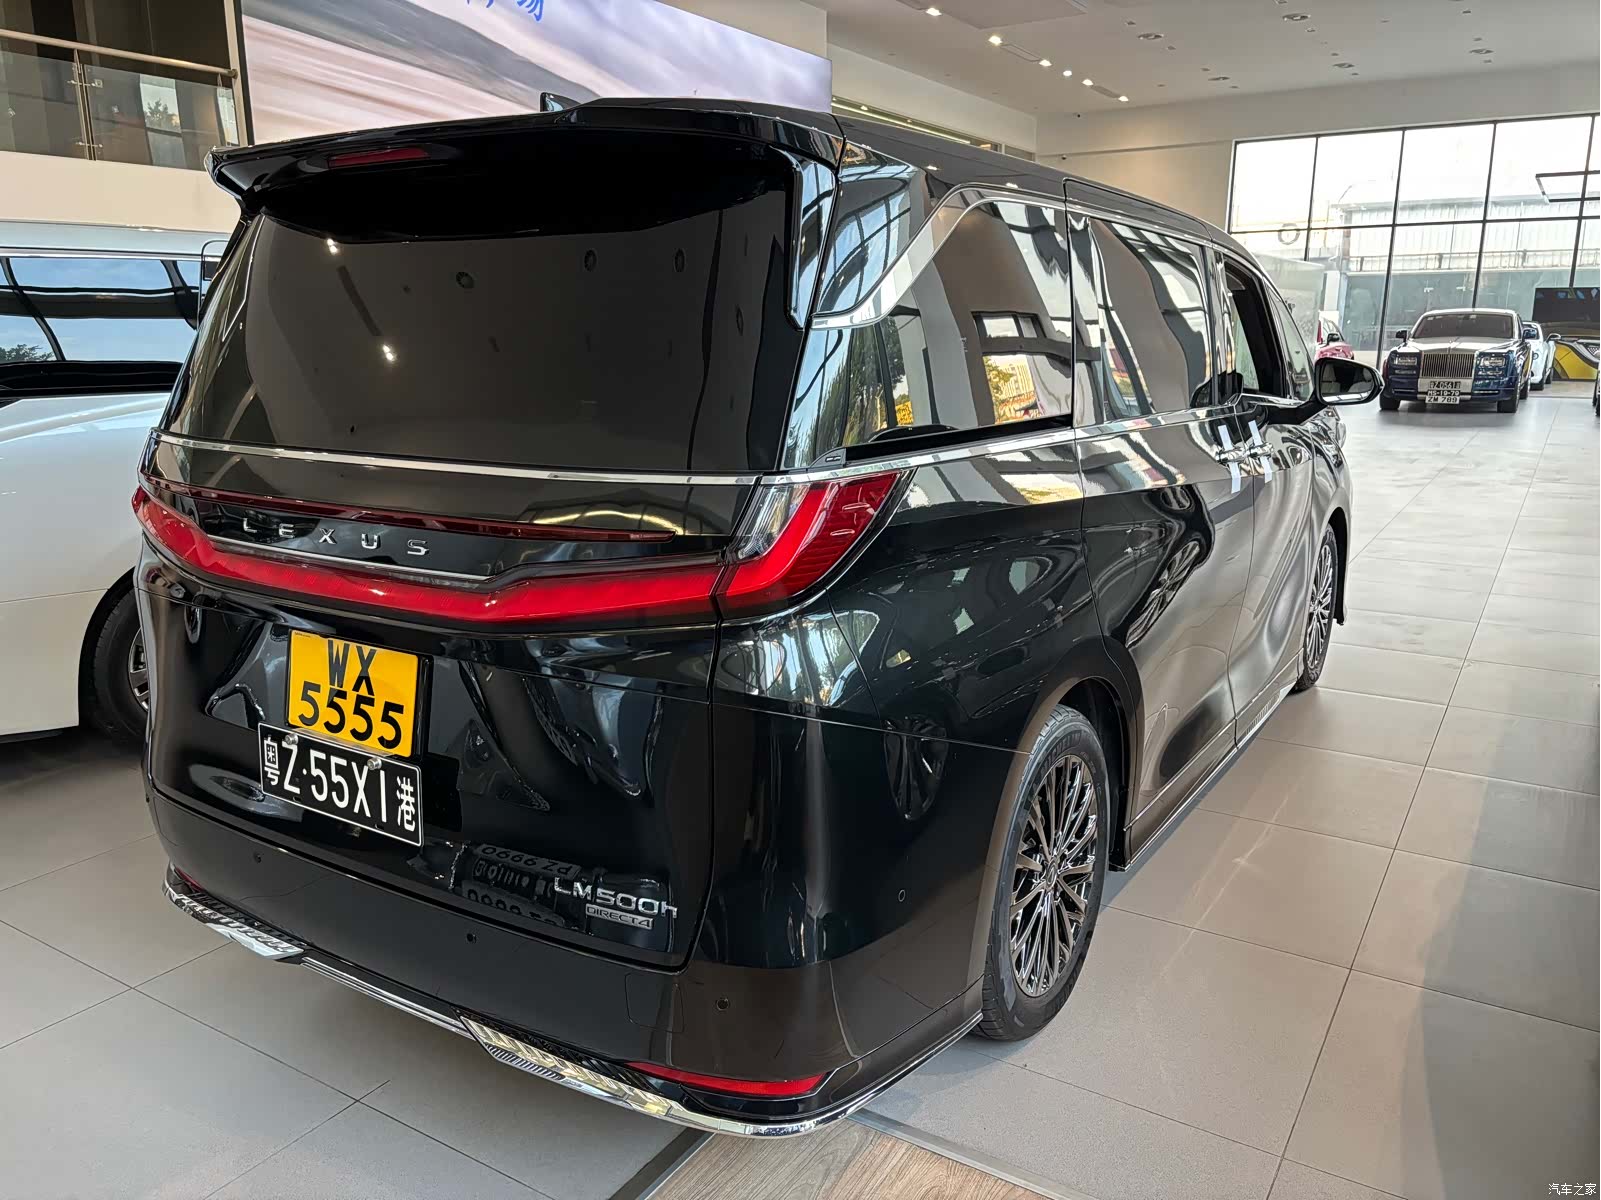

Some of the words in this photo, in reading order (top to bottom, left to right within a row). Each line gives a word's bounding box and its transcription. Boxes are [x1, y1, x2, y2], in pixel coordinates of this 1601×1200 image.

[243, 517, 429, 556] LEXUS
[328, 639, 377, 696] WX
[298, 681, 404, 750] 5555
[586, 905, 653, 929] DIRECT4
